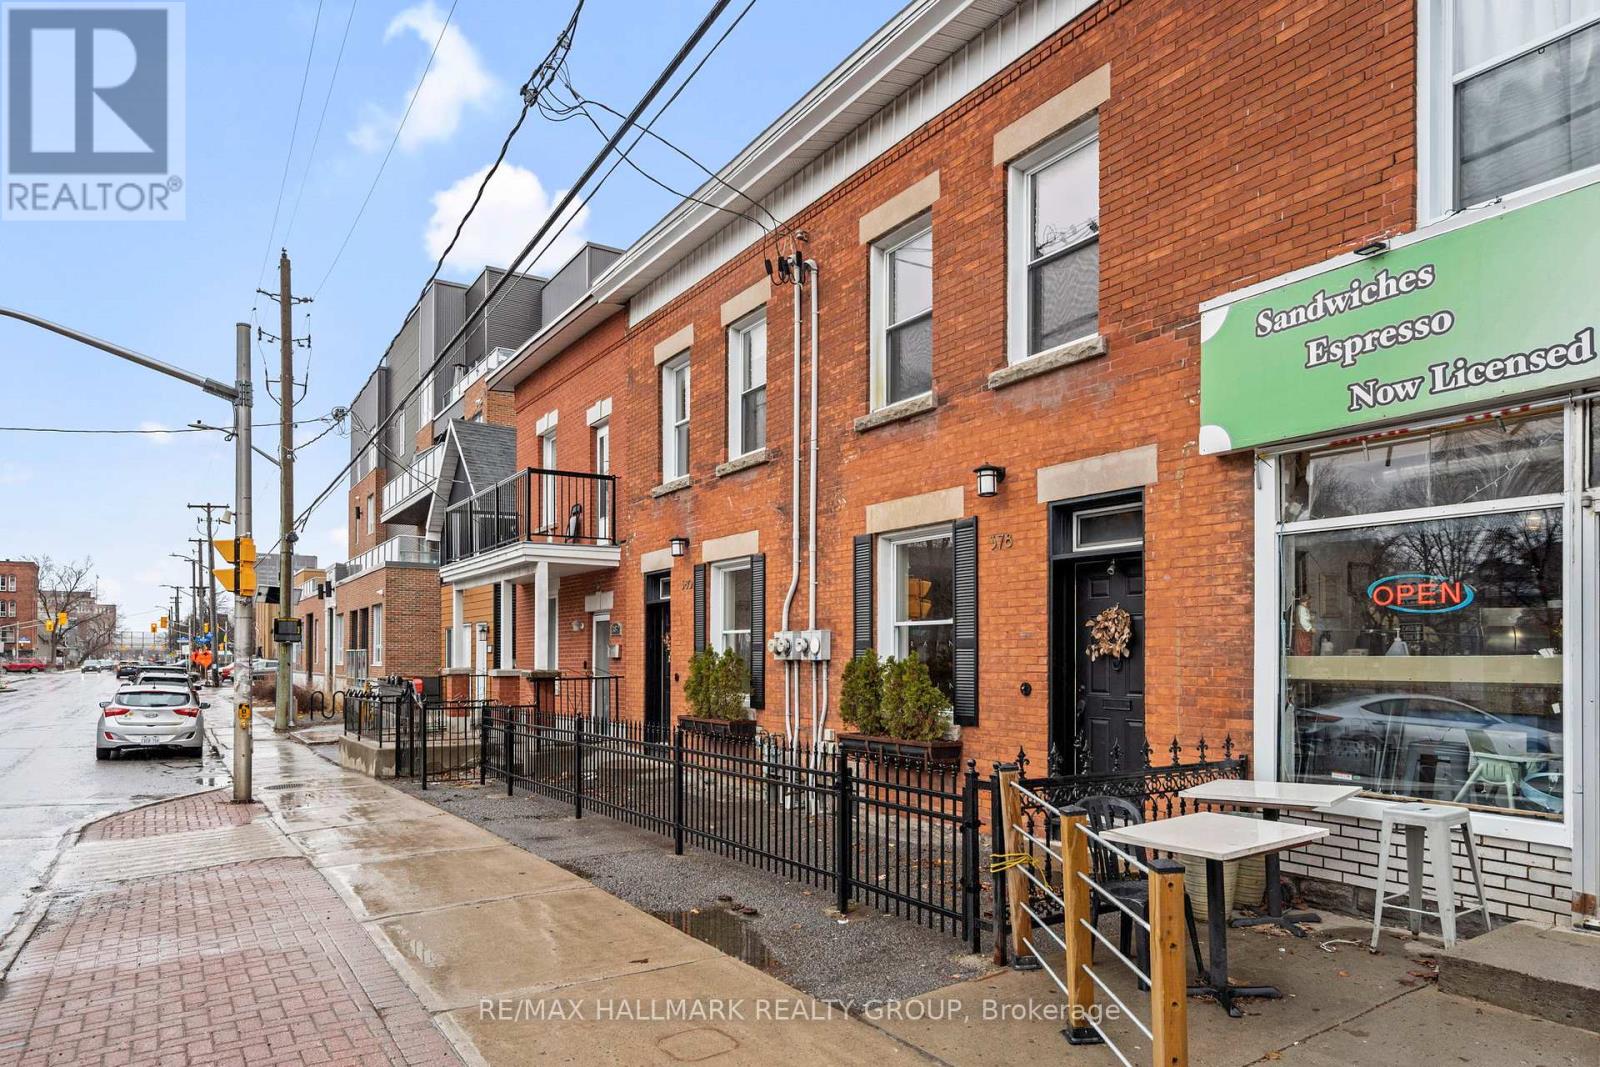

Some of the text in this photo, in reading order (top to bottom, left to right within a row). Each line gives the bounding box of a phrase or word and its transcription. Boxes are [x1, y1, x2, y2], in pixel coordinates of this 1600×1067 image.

[1256, 264, 1435, 337] Sandwiches
[1305, 310, 1455, 368] Espresso
[1348, 327, 1596, 412] Now Licensed
[1372, 581, 1462, 606] OPEN
